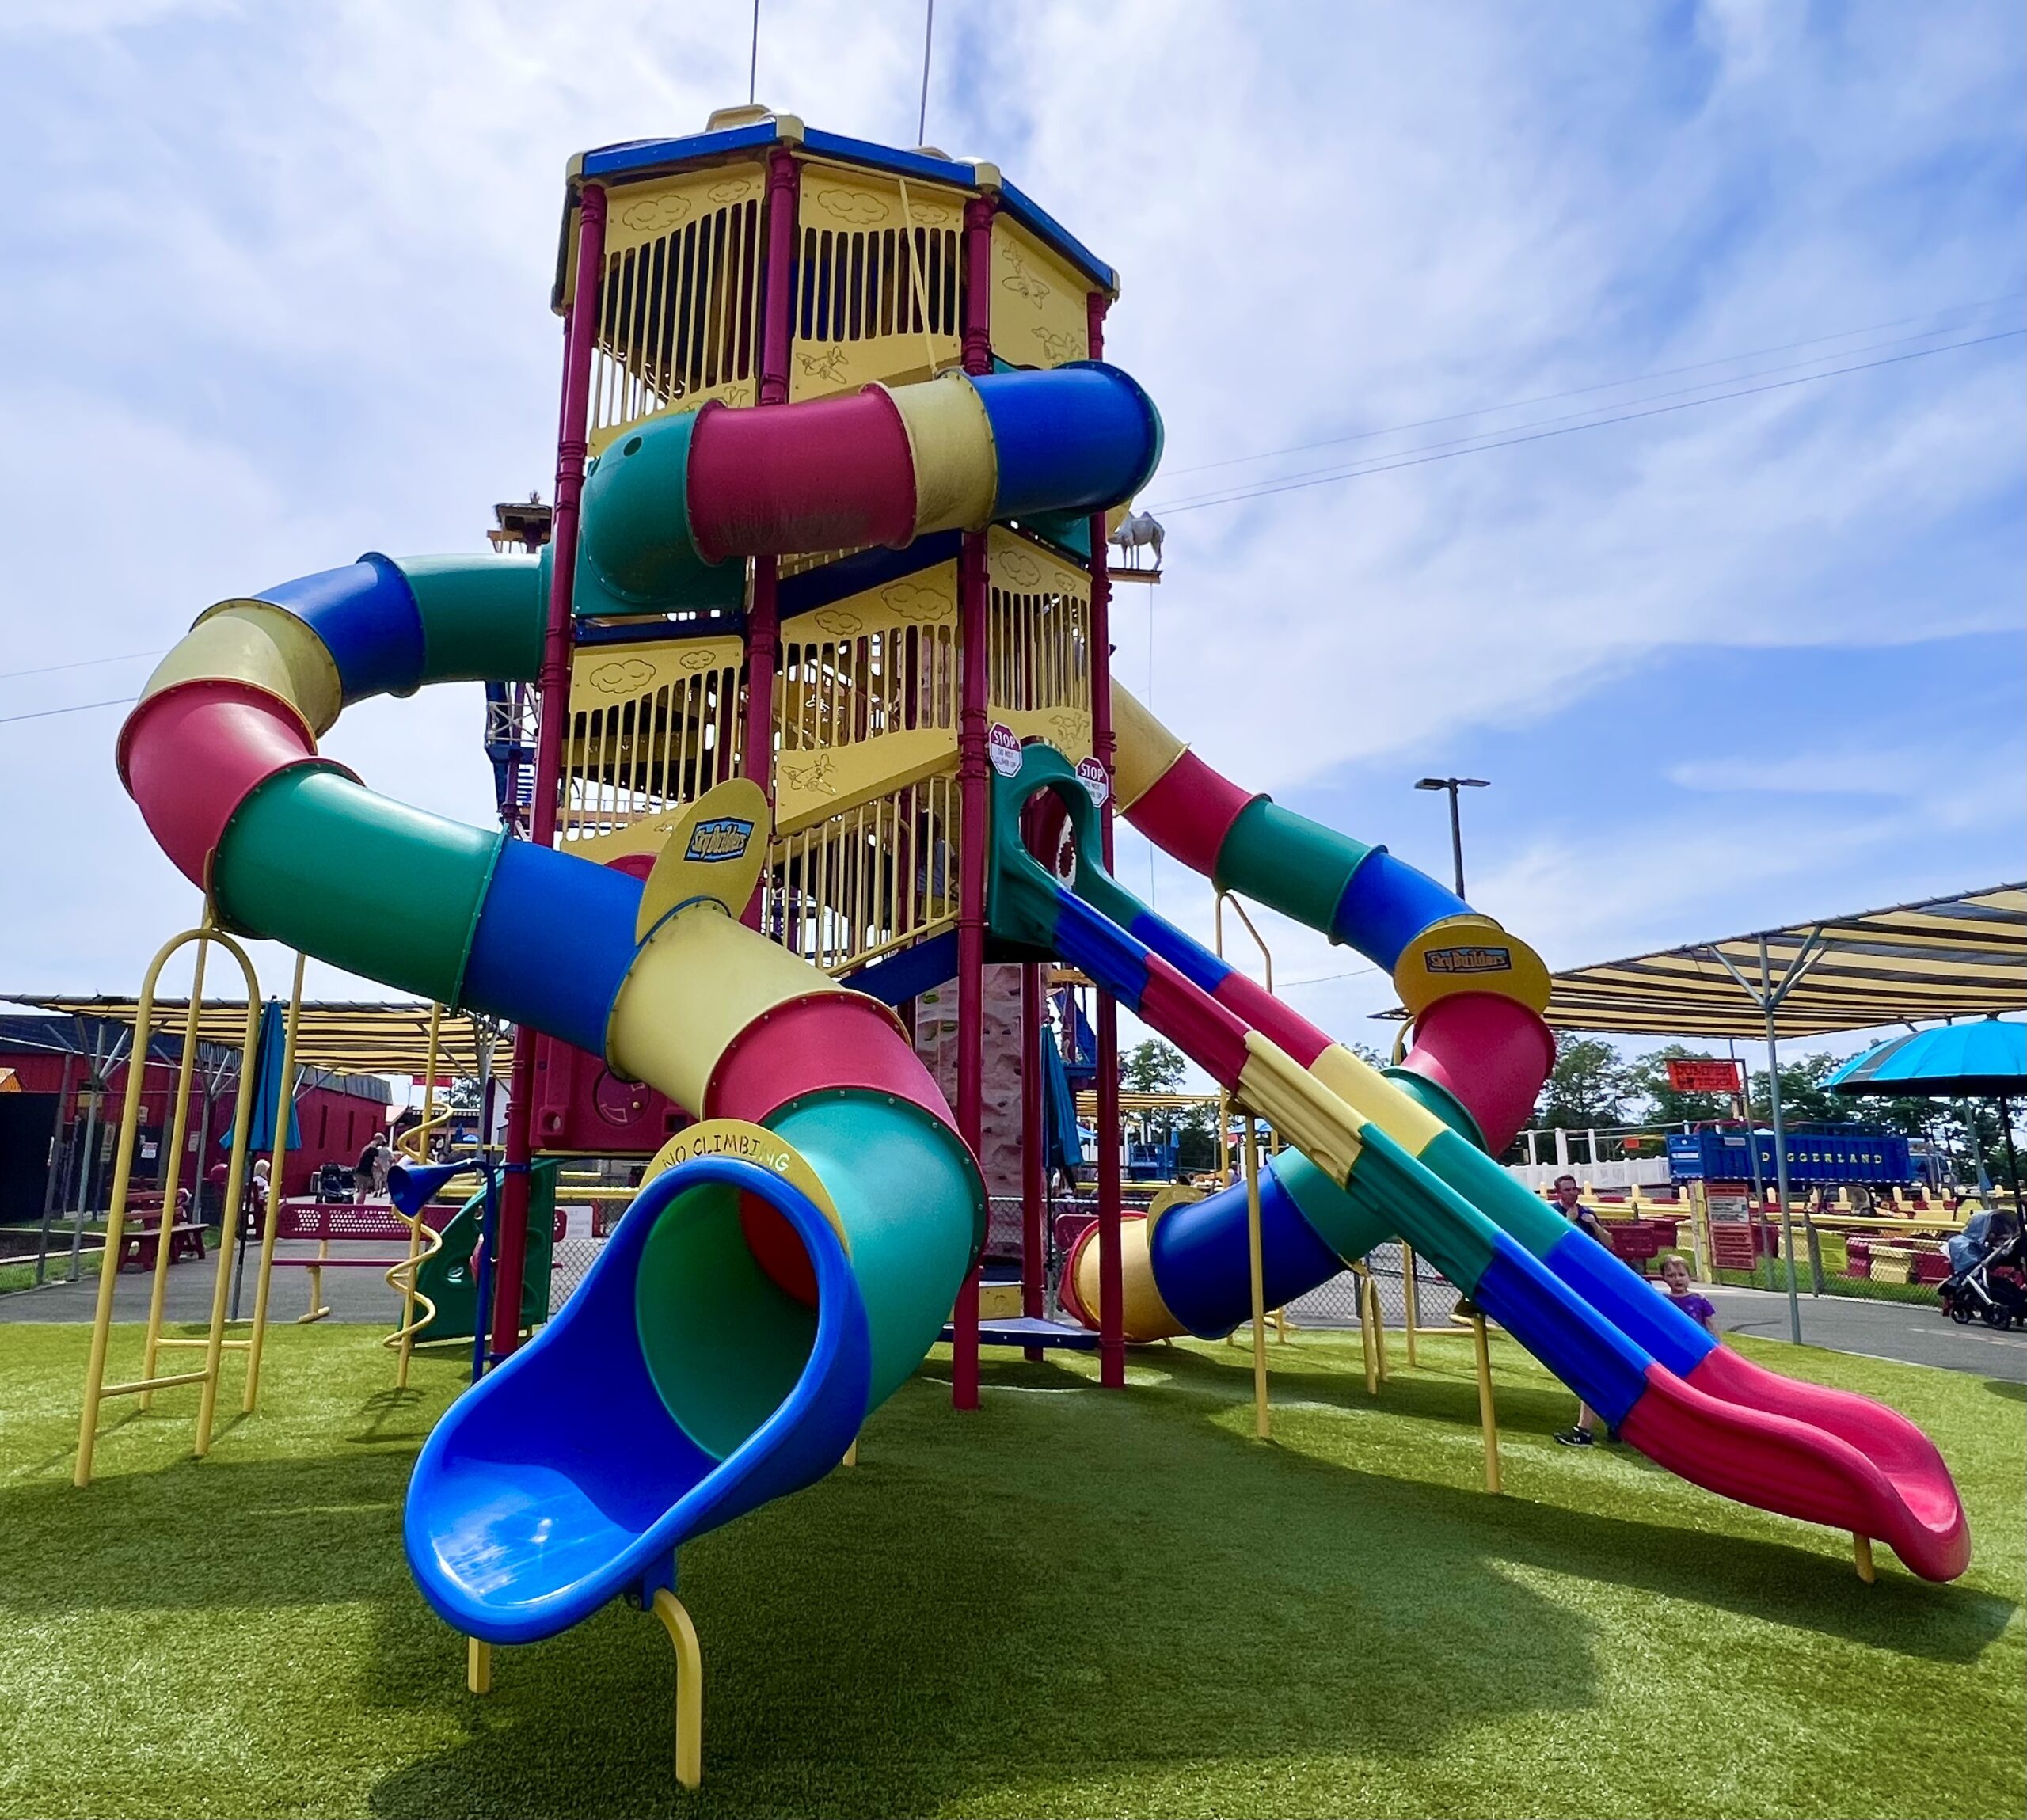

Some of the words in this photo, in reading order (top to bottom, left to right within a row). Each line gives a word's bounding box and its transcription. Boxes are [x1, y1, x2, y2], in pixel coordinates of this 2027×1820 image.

[993, 730, 1016, 749] STOP
[1081, 763, 1104, 781] STOP
[662, 1146, 686, 1168] NO
[692, 1133, 790, 1172] CLIMBING
[1761, 1151, 1883, 1165] DGGERLAND
